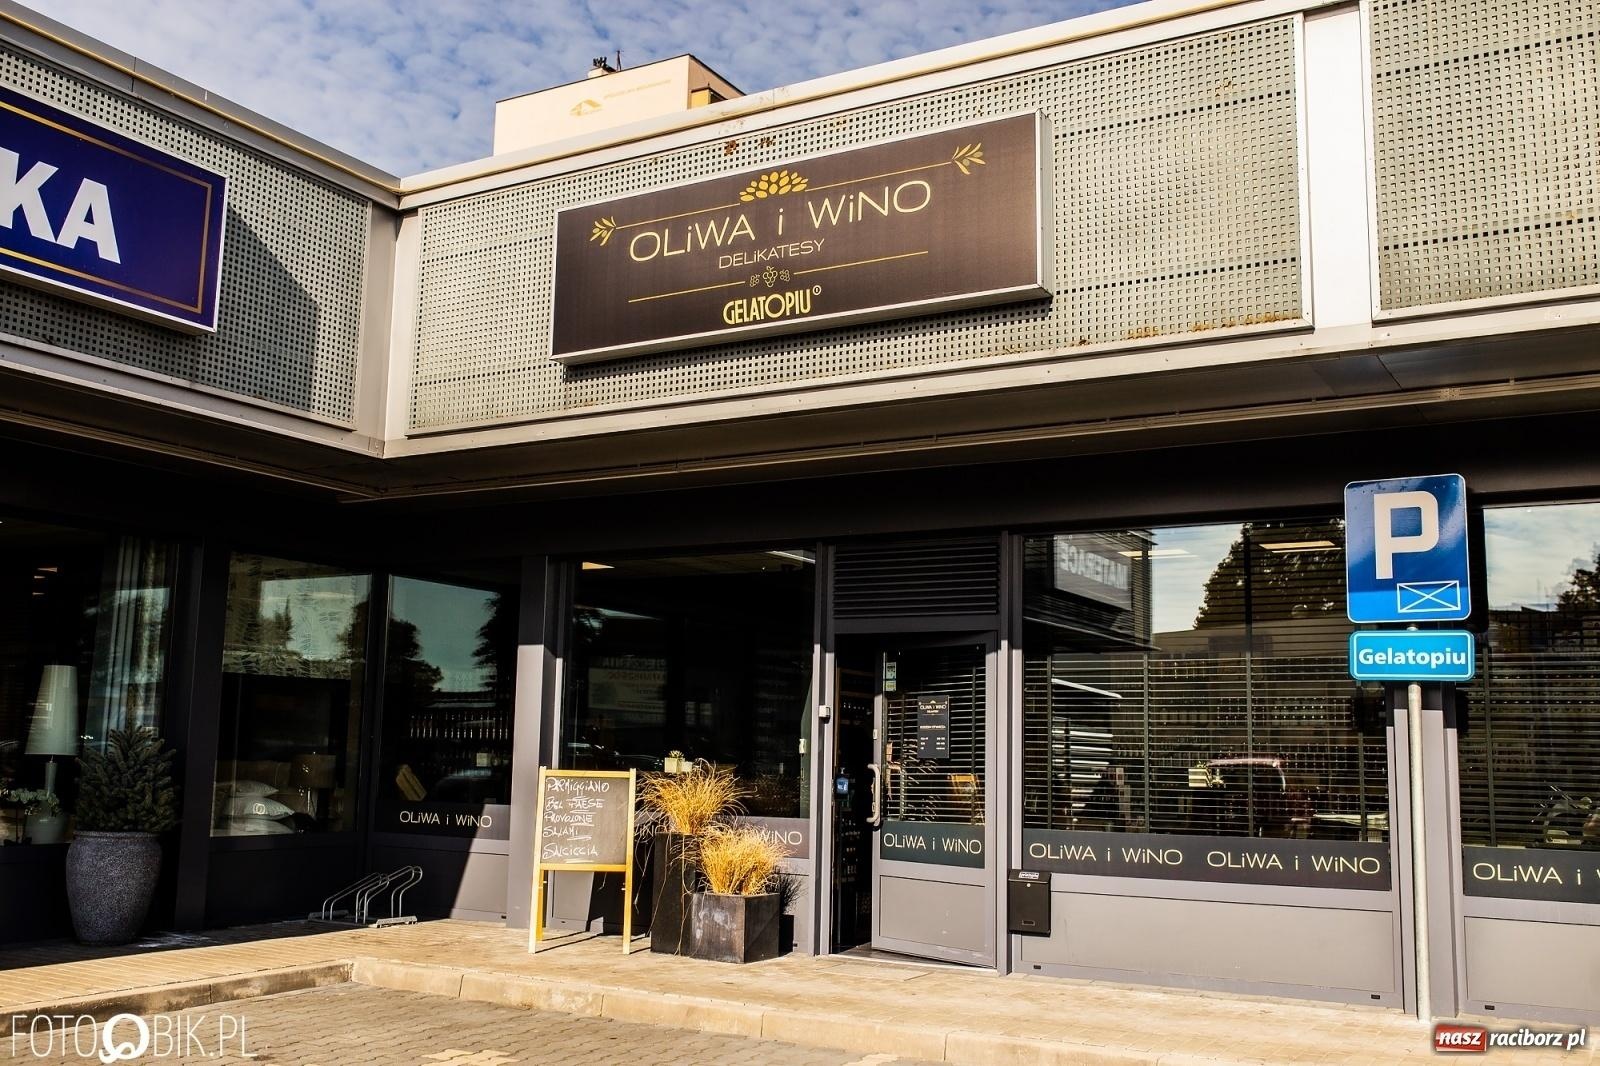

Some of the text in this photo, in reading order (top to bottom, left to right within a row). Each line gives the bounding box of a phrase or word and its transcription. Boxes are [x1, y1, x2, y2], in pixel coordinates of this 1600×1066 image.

[0, 146, 121, 264] KA
[629, 180, 931, 262] OLiWA i WiNO
[718, 238, 825, 269] DELiKATESY
[1373, 490, 1439, 580] P
[1358, 648, 1466, 669] Gelatopiu
[399, 811, 493, 828] OLiWA i WiNO
[883, 833, 982, 854] OLiWA i WiNO
[1029, 843, 1381, 875] OLiWA i WiNO OLiWA i WiNO
[1473, 863, 1563, 884] OLiWA
[1577, 869, 1581, 885] i
